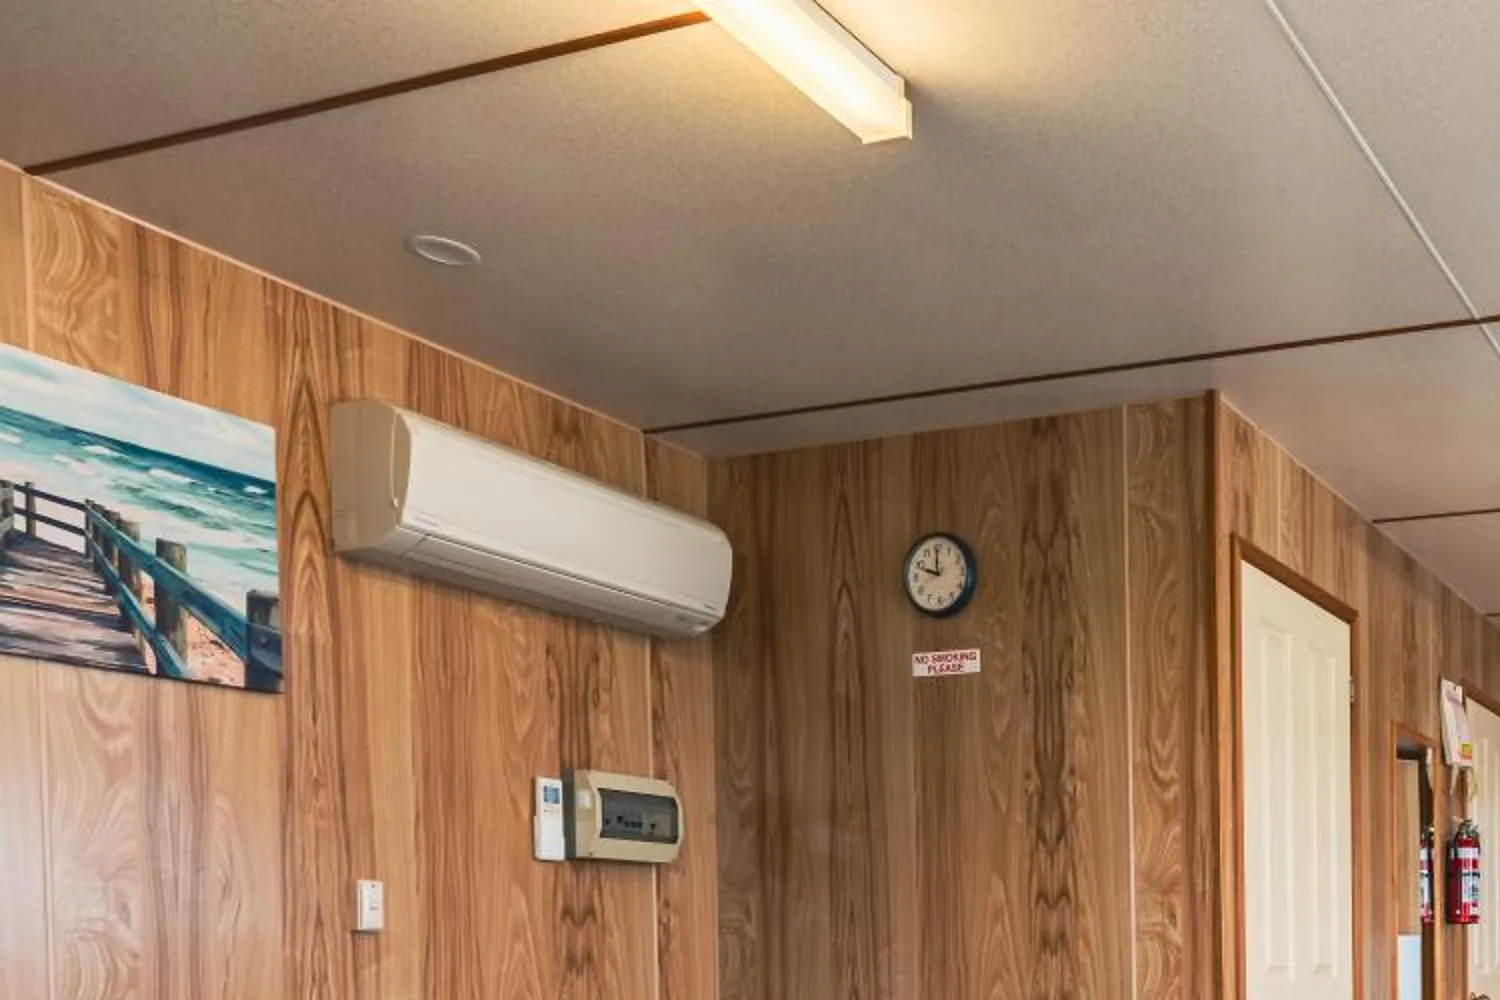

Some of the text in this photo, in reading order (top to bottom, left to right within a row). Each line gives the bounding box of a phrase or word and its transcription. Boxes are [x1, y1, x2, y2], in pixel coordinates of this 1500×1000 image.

[914, 651, 977, 665] NO SMOKING
[927, 663, 965, 674] PLEASE
